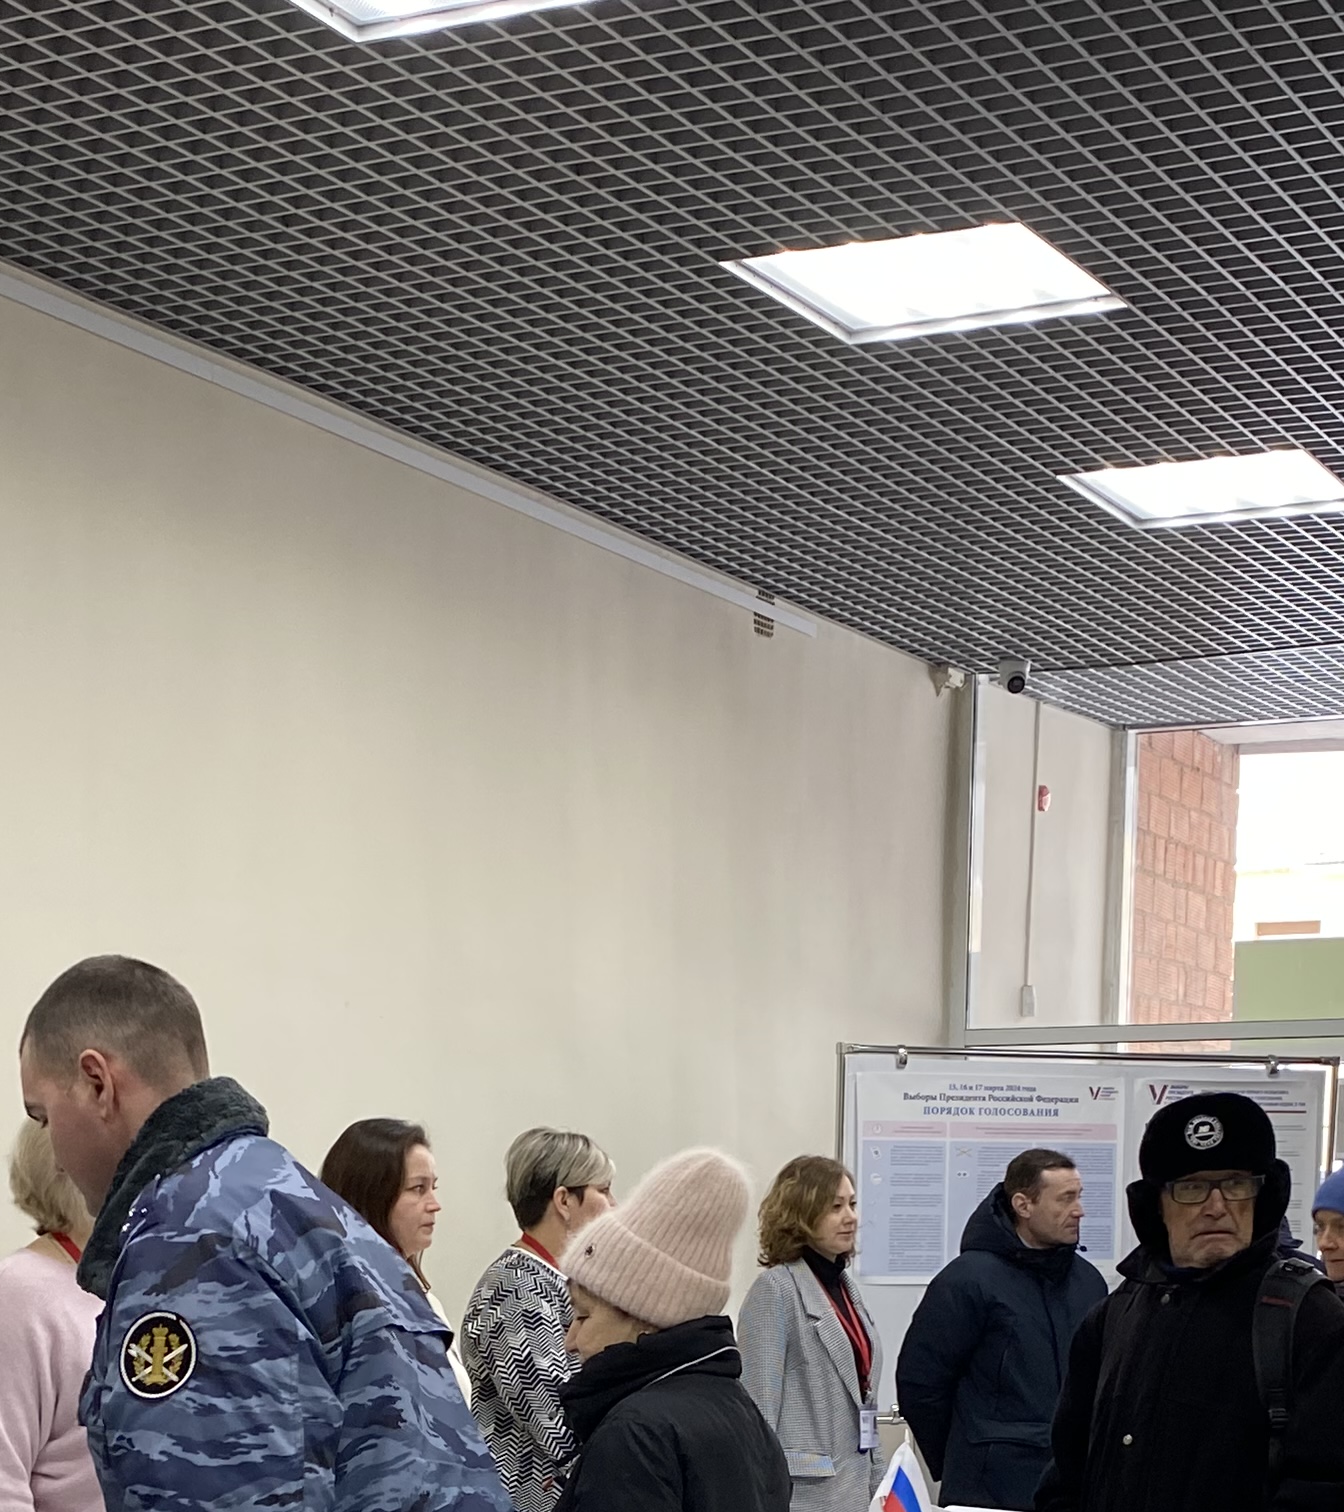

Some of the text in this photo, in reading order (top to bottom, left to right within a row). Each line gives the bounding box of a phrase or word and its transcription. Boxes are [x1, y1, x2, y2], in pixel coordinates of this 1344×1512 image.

[903, 1092, 937, 1103] Выборы
[923, 1106, 1059, 1117] ПОРЯДОК ГОЛОСОВАНИЯ
